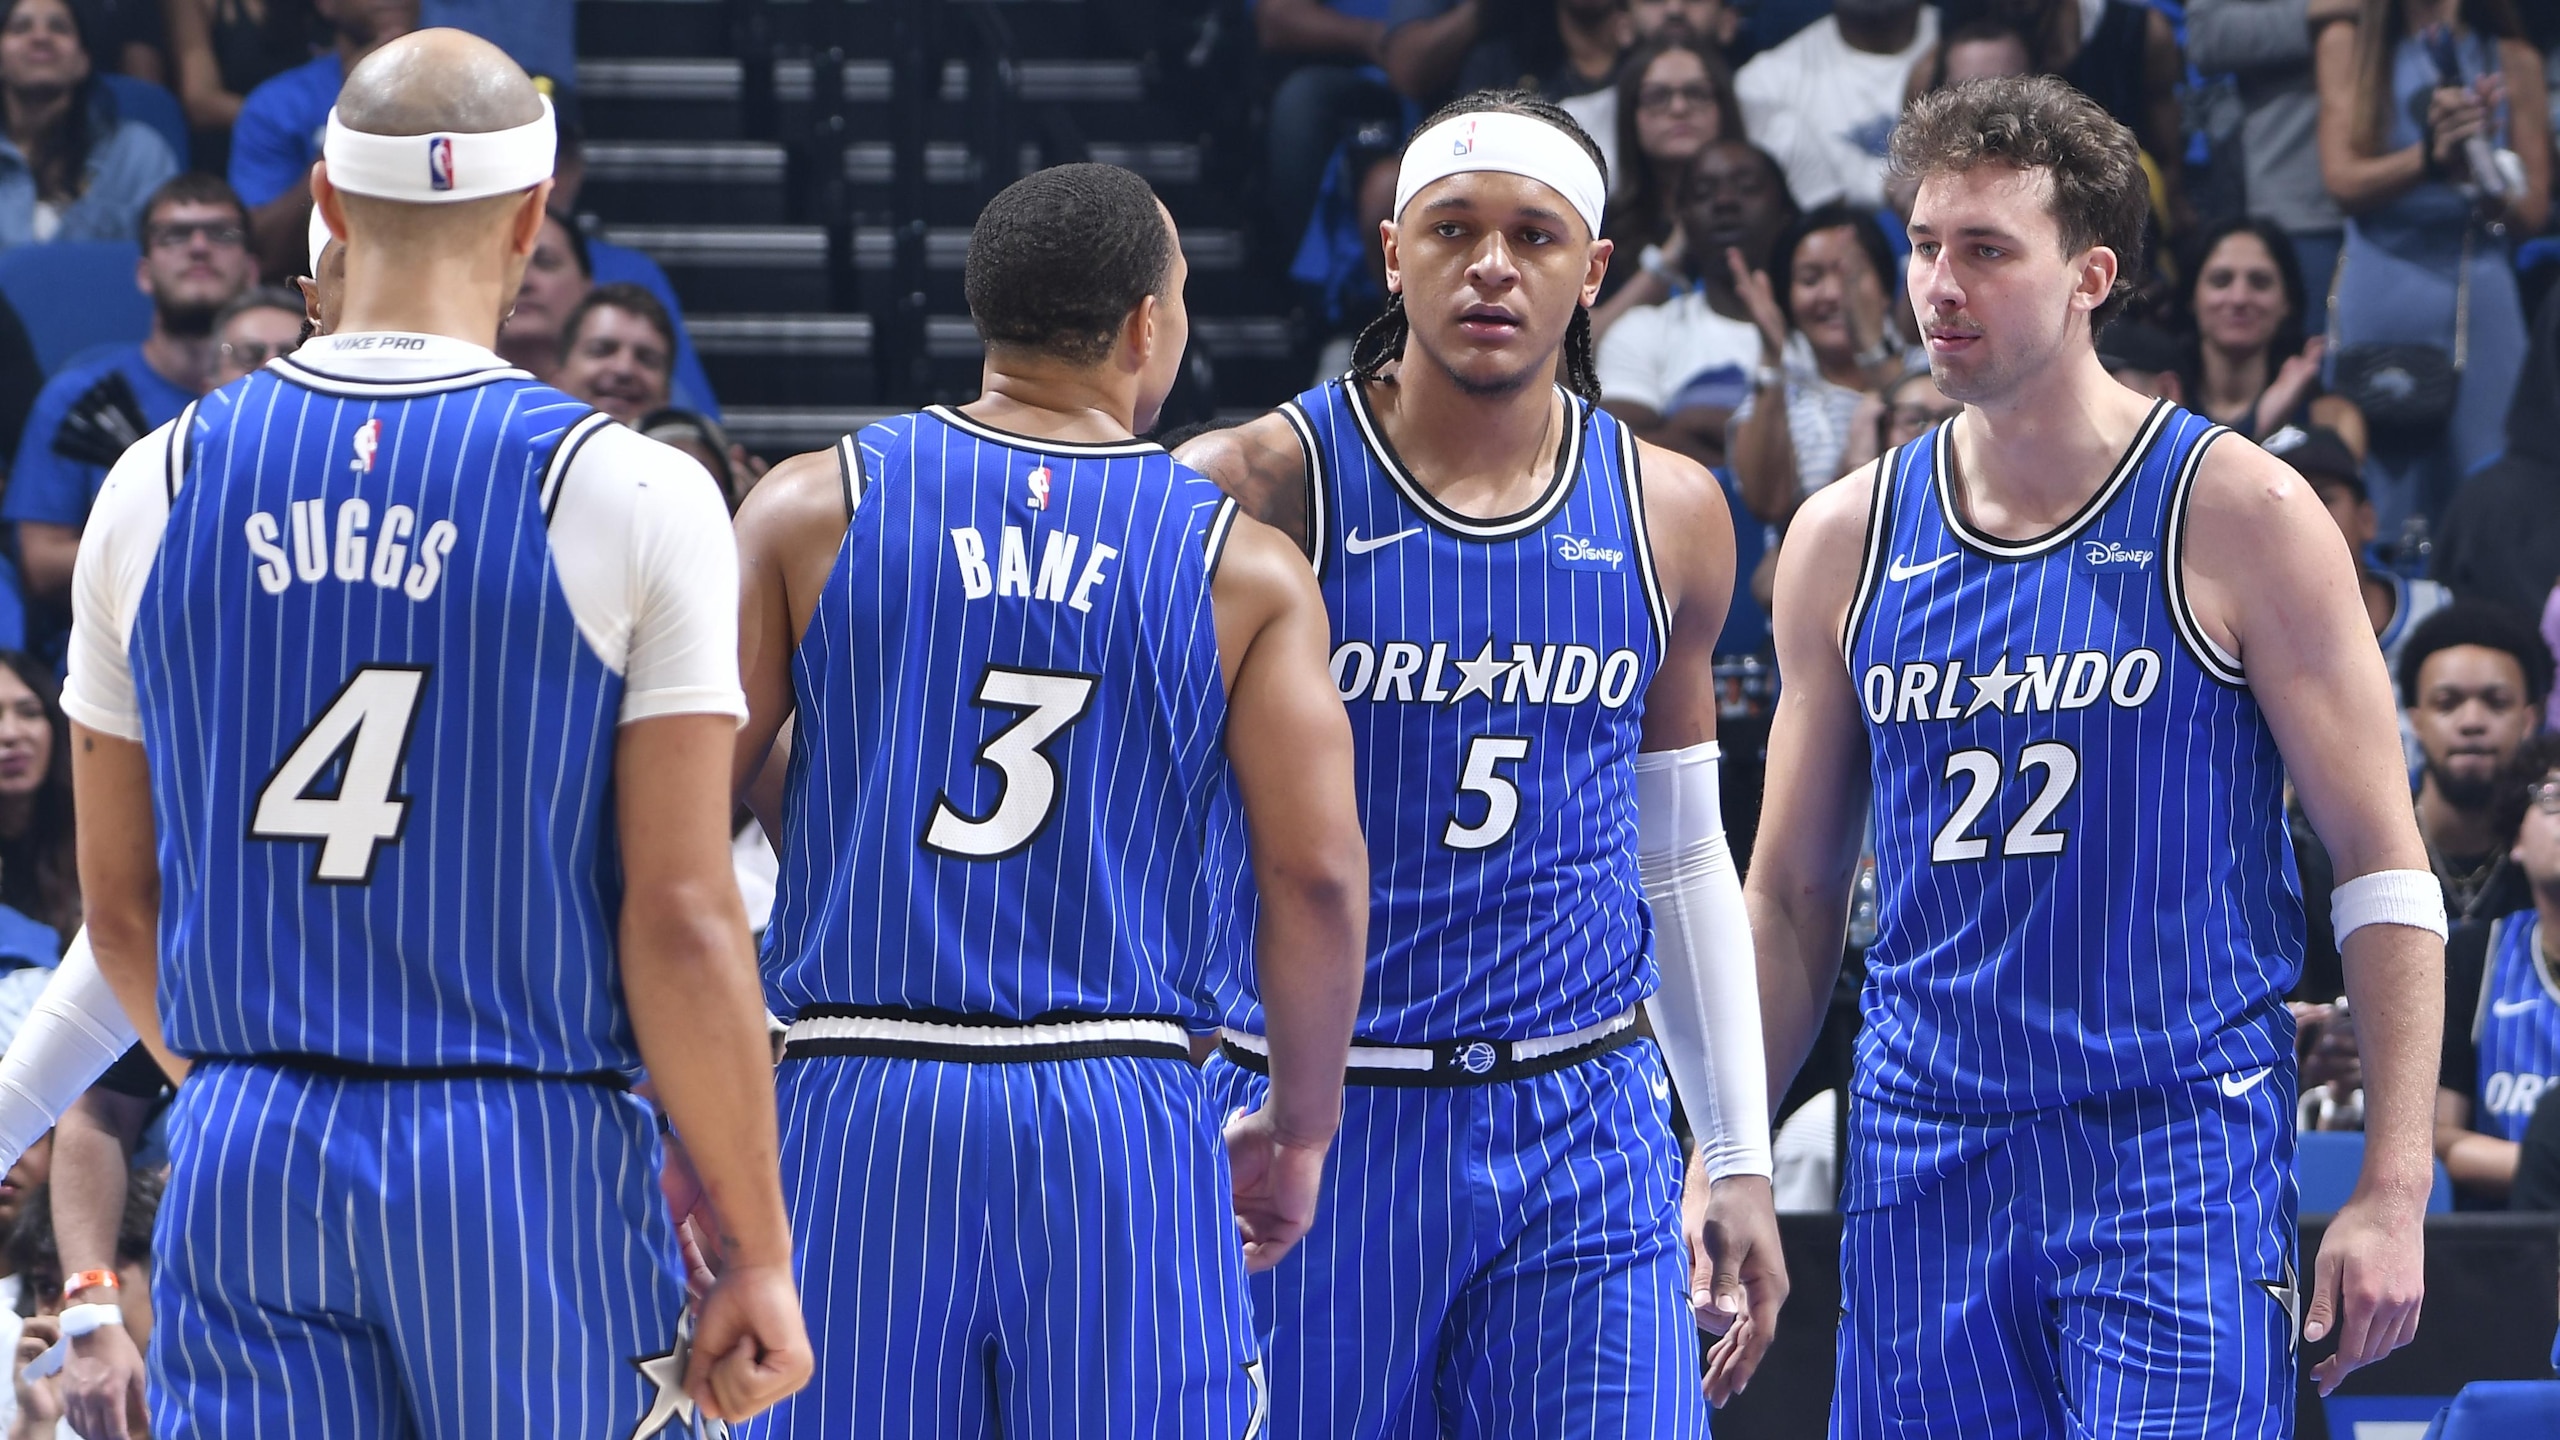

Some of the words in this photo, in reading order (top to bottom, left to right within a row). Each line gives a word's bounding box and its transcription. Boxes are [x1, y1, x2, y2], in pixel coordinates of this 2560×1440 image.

[331, 337, 377, 351] NIKE
[379, 337, 426, 351] PRO
[243, 497, 459, 602] SUGGS
[949, 525, 1119, 614] BANE
[247, 663, 432, 886] 4
[918, 662, 1102, 863] 3
[1439, 734, 1534, 851] 5
[1928, 739, 2081, 865] 22
